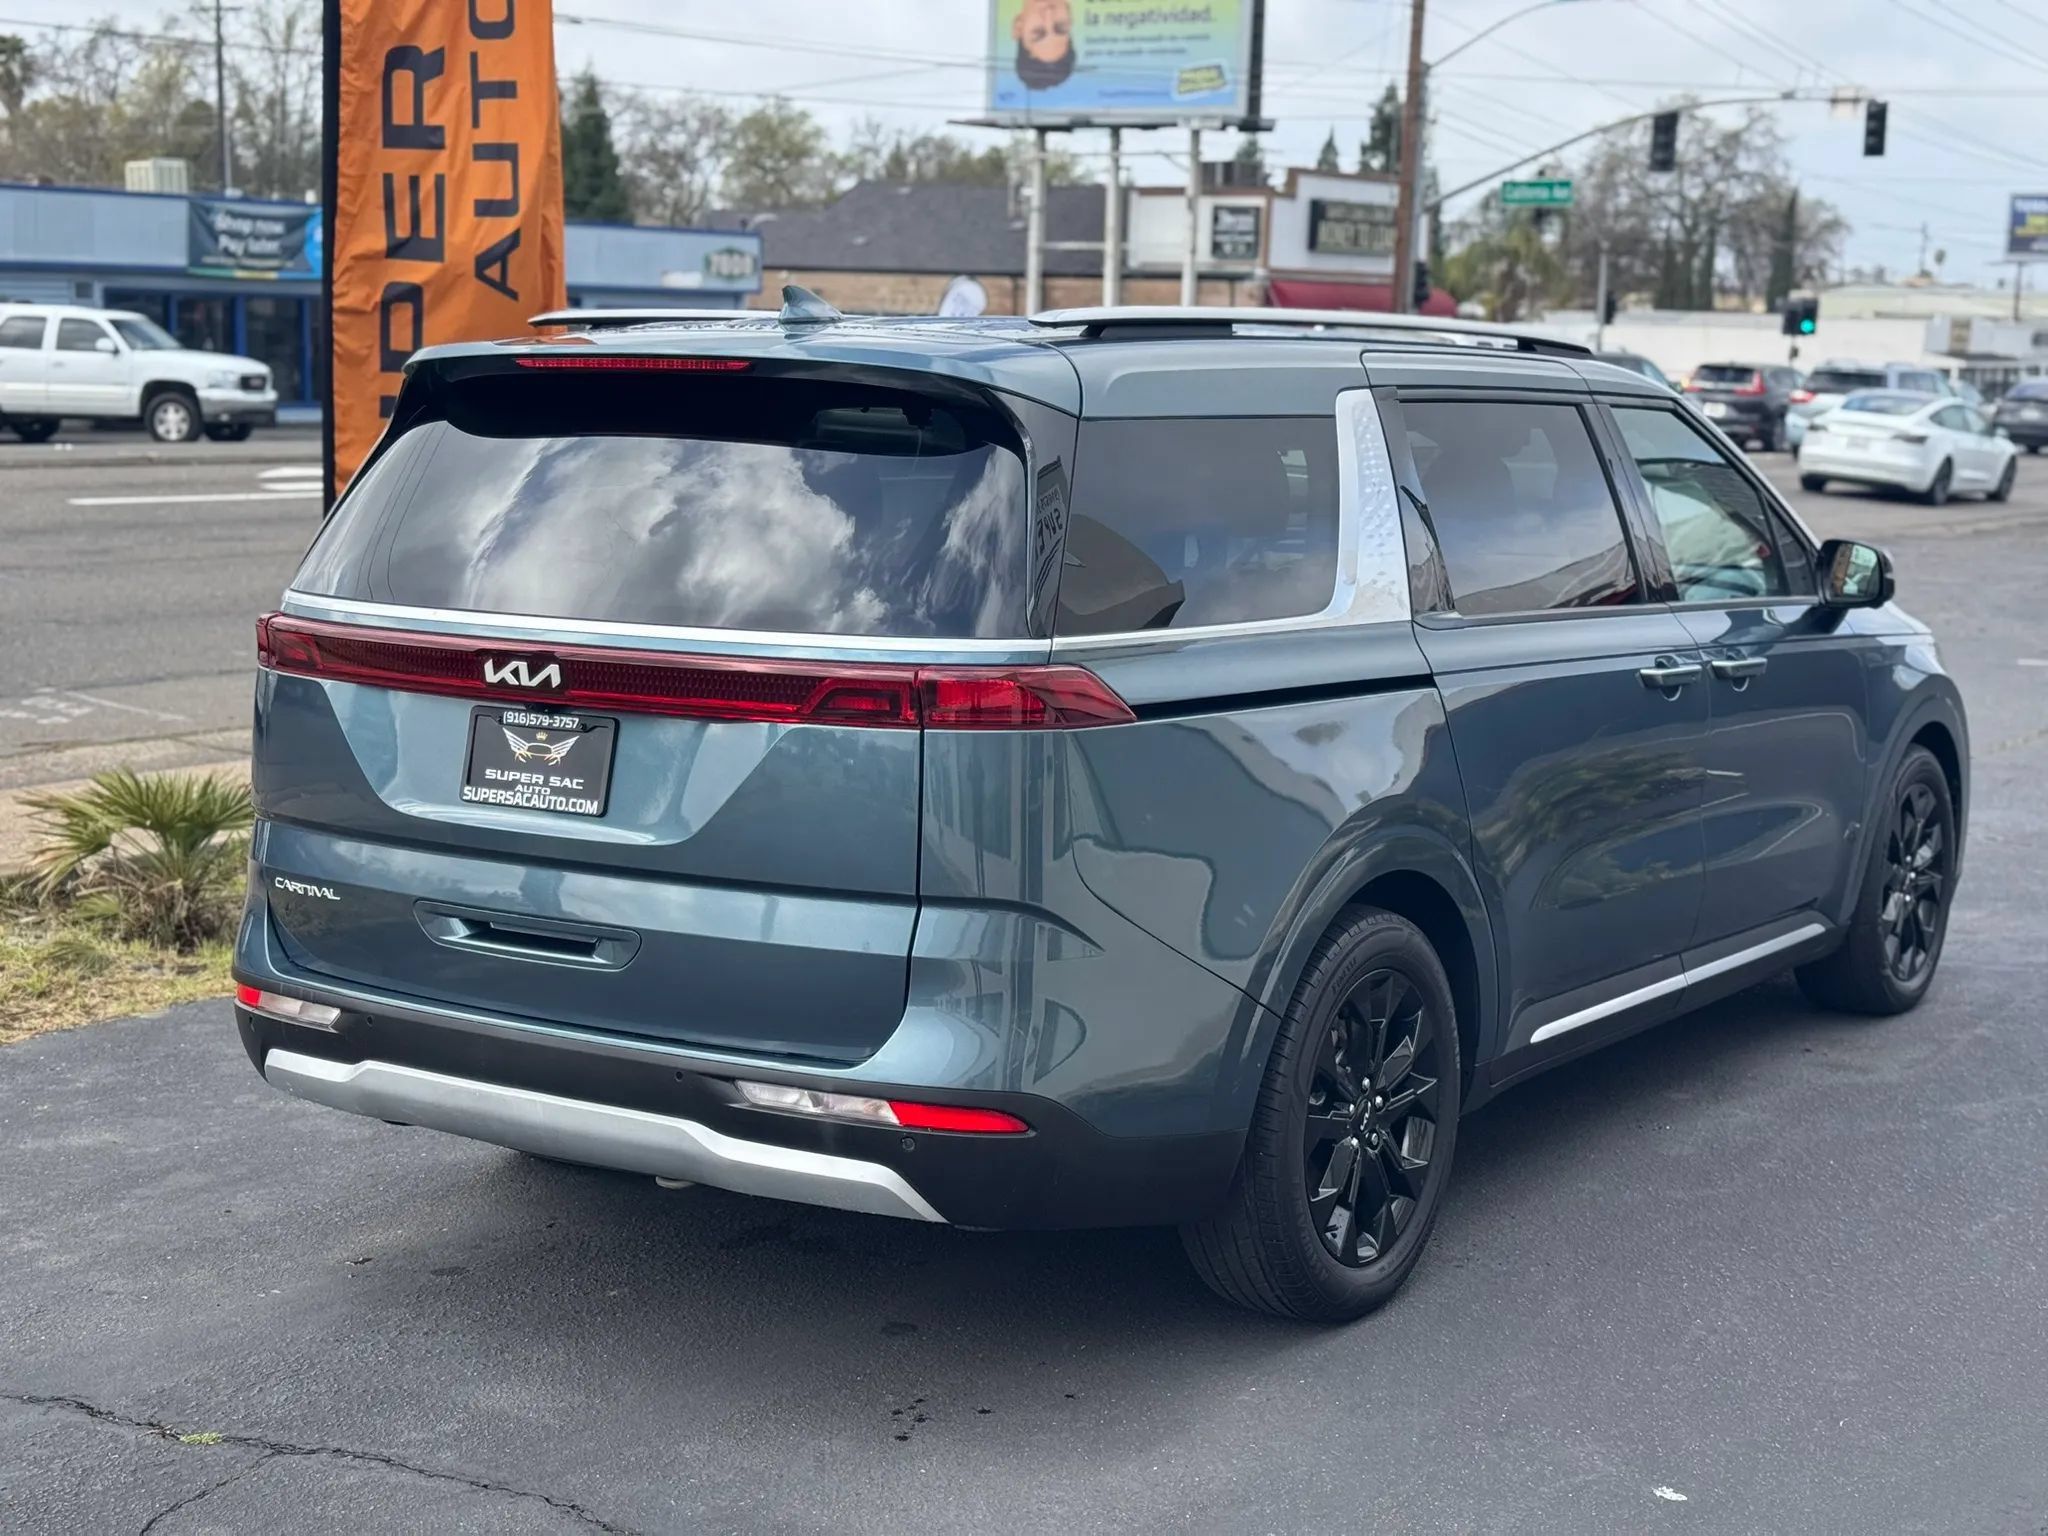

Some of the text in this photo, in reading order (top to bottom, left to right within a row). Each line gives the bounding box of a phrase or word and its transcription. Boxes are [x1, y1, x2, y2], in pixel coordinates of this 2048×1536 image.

[378, 44, 446, 419] PER
[484, 658, 562, 689] KIA
[503, 711, 579, 729] (916)579-3757
[485, 768, 585, 790] SUPER SAC
[514, 784, 551, 796] AUTO
[462, 786, 599, 815] SUPERSACAUTO.COM
[274, 876, 341, 900] CARNIVAL
